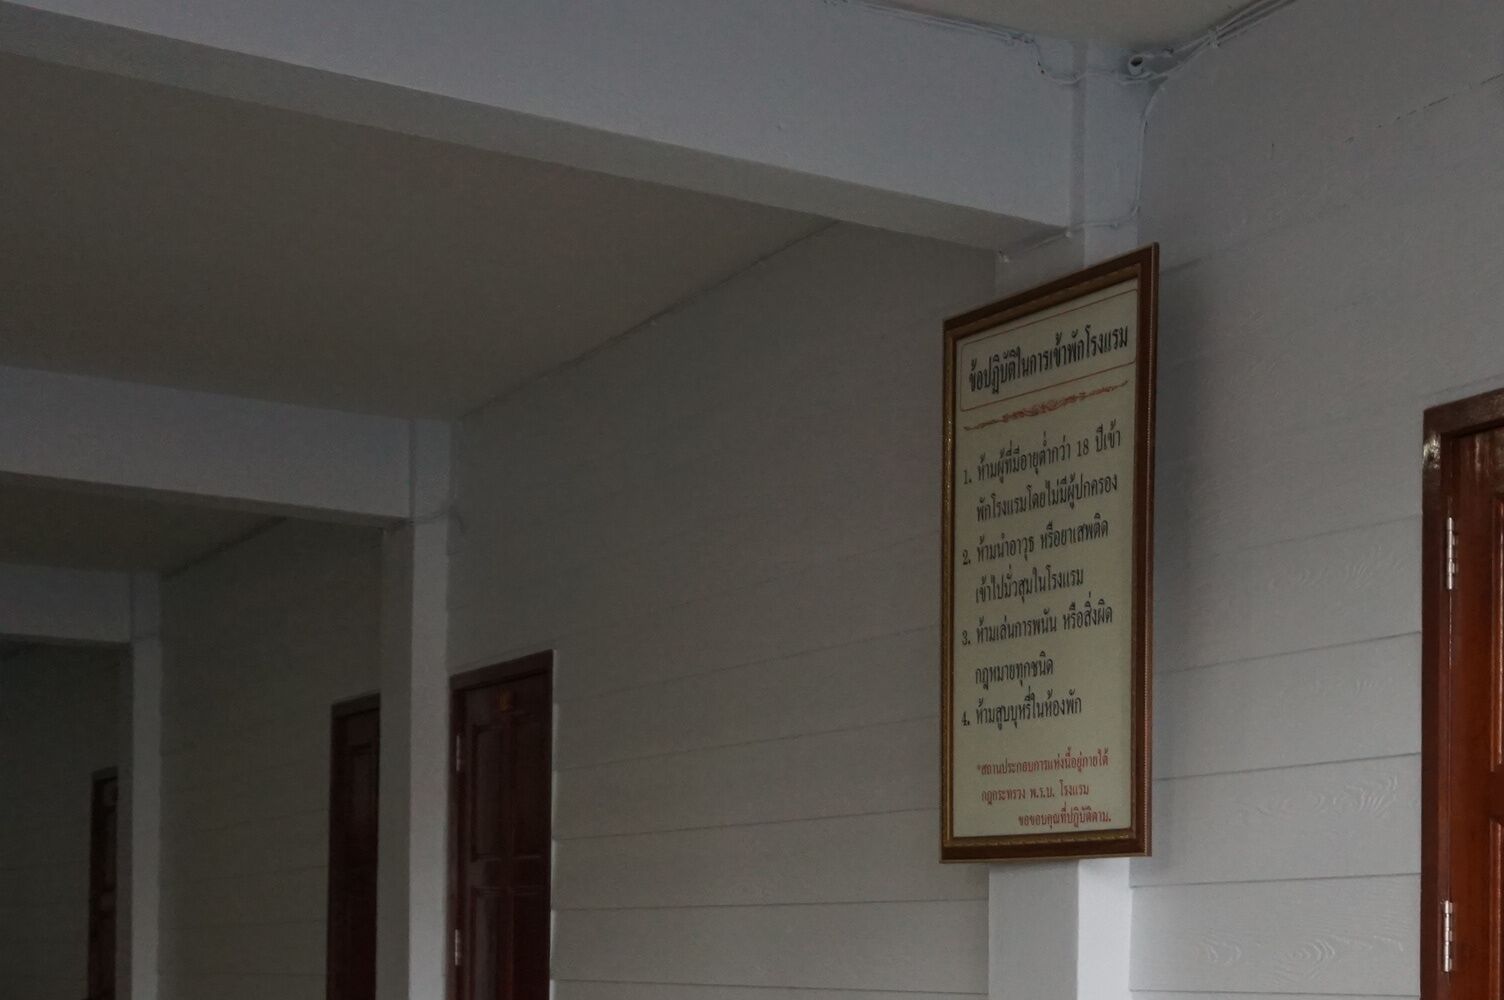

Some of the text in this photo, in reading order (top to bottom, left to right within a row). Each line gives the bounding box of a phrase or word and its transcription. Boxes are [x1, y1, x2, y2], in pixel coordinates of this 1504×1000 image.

[963, 469, 972, 485] 1.
[1076, 438, 1090, 457] 18
[962, 549, 971, 566] 2.
[961, 630, 971, 646] 3.
[961, 686, 1082, 730] 4. ห้ามสูบบุหรี่ในห้องพัก
